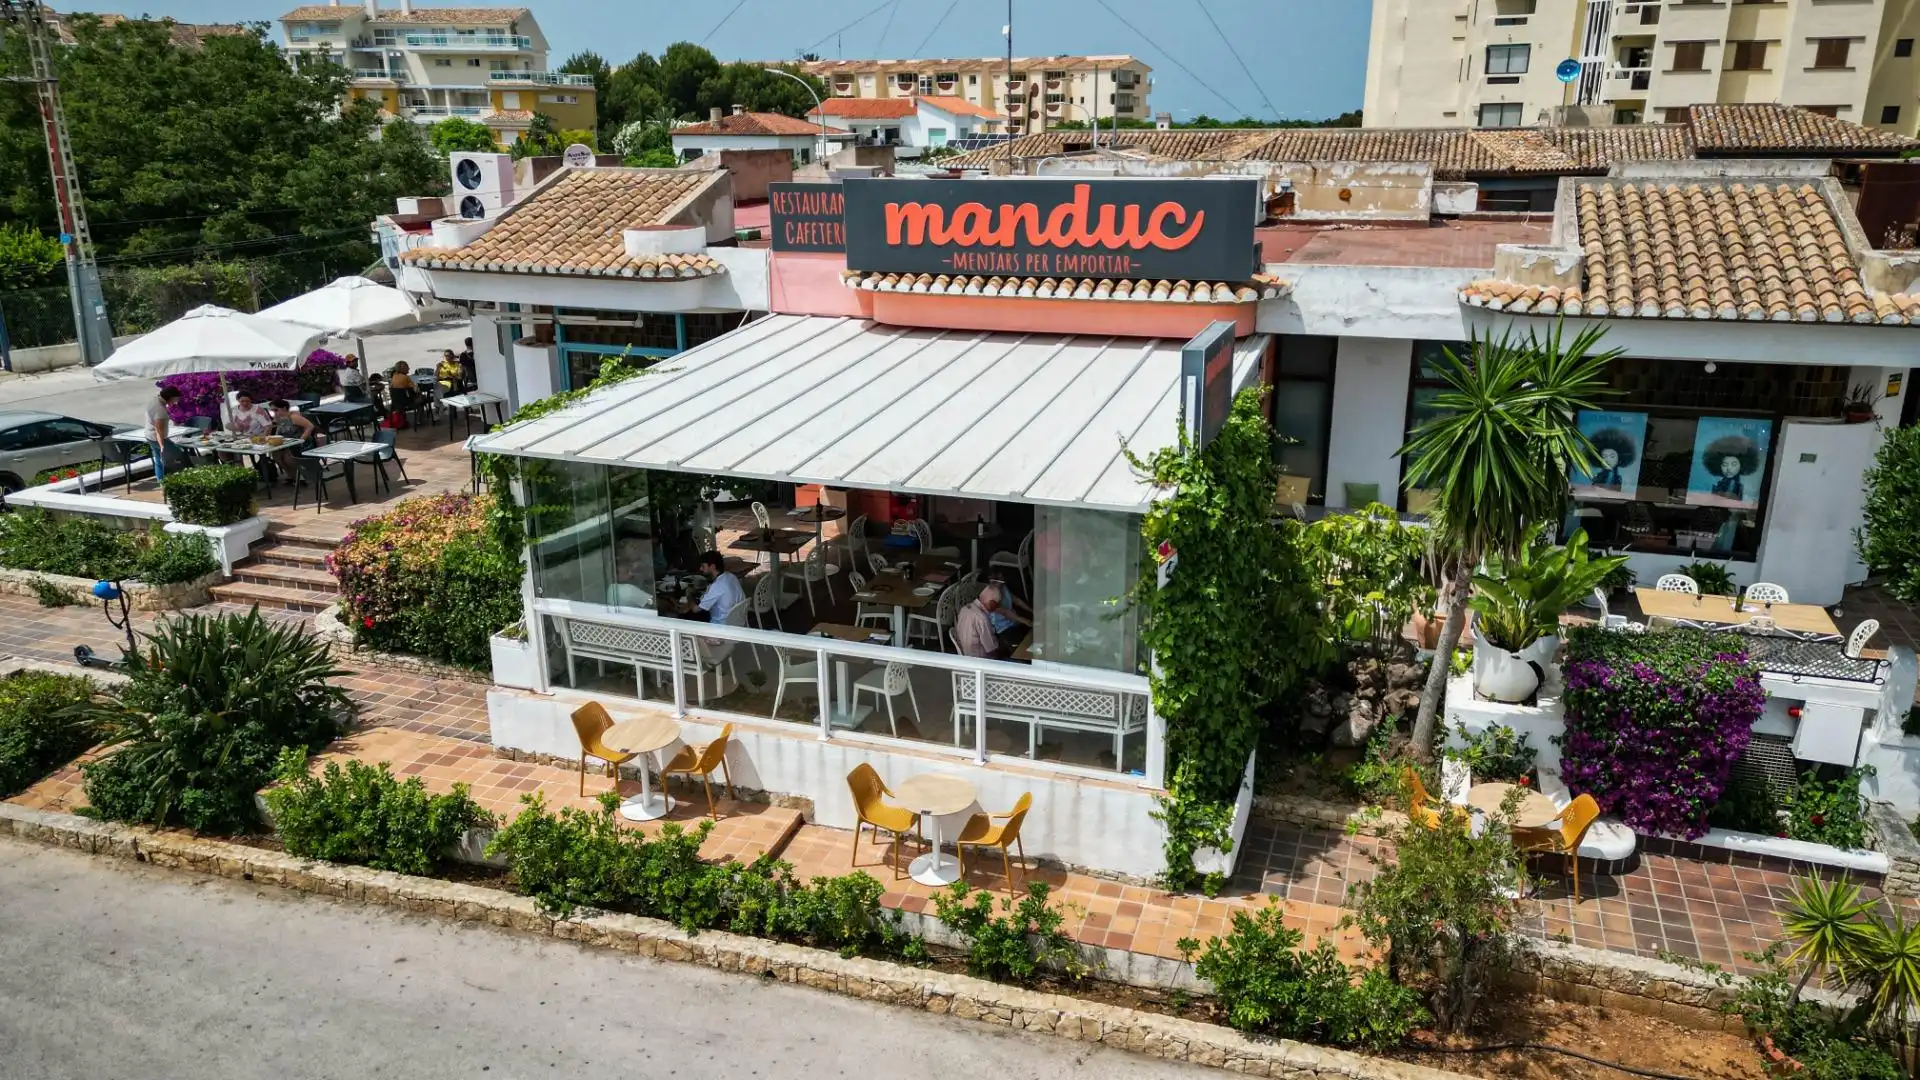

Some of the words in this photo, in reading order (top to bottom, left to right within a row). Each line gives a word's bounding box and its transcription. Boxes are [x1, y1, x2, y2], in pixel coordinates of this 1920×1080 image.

[884, 183, 1205, 250] manduc
[1025, 253, 1049, 273] PER
[257, 361, 290, 369] AMBAR
